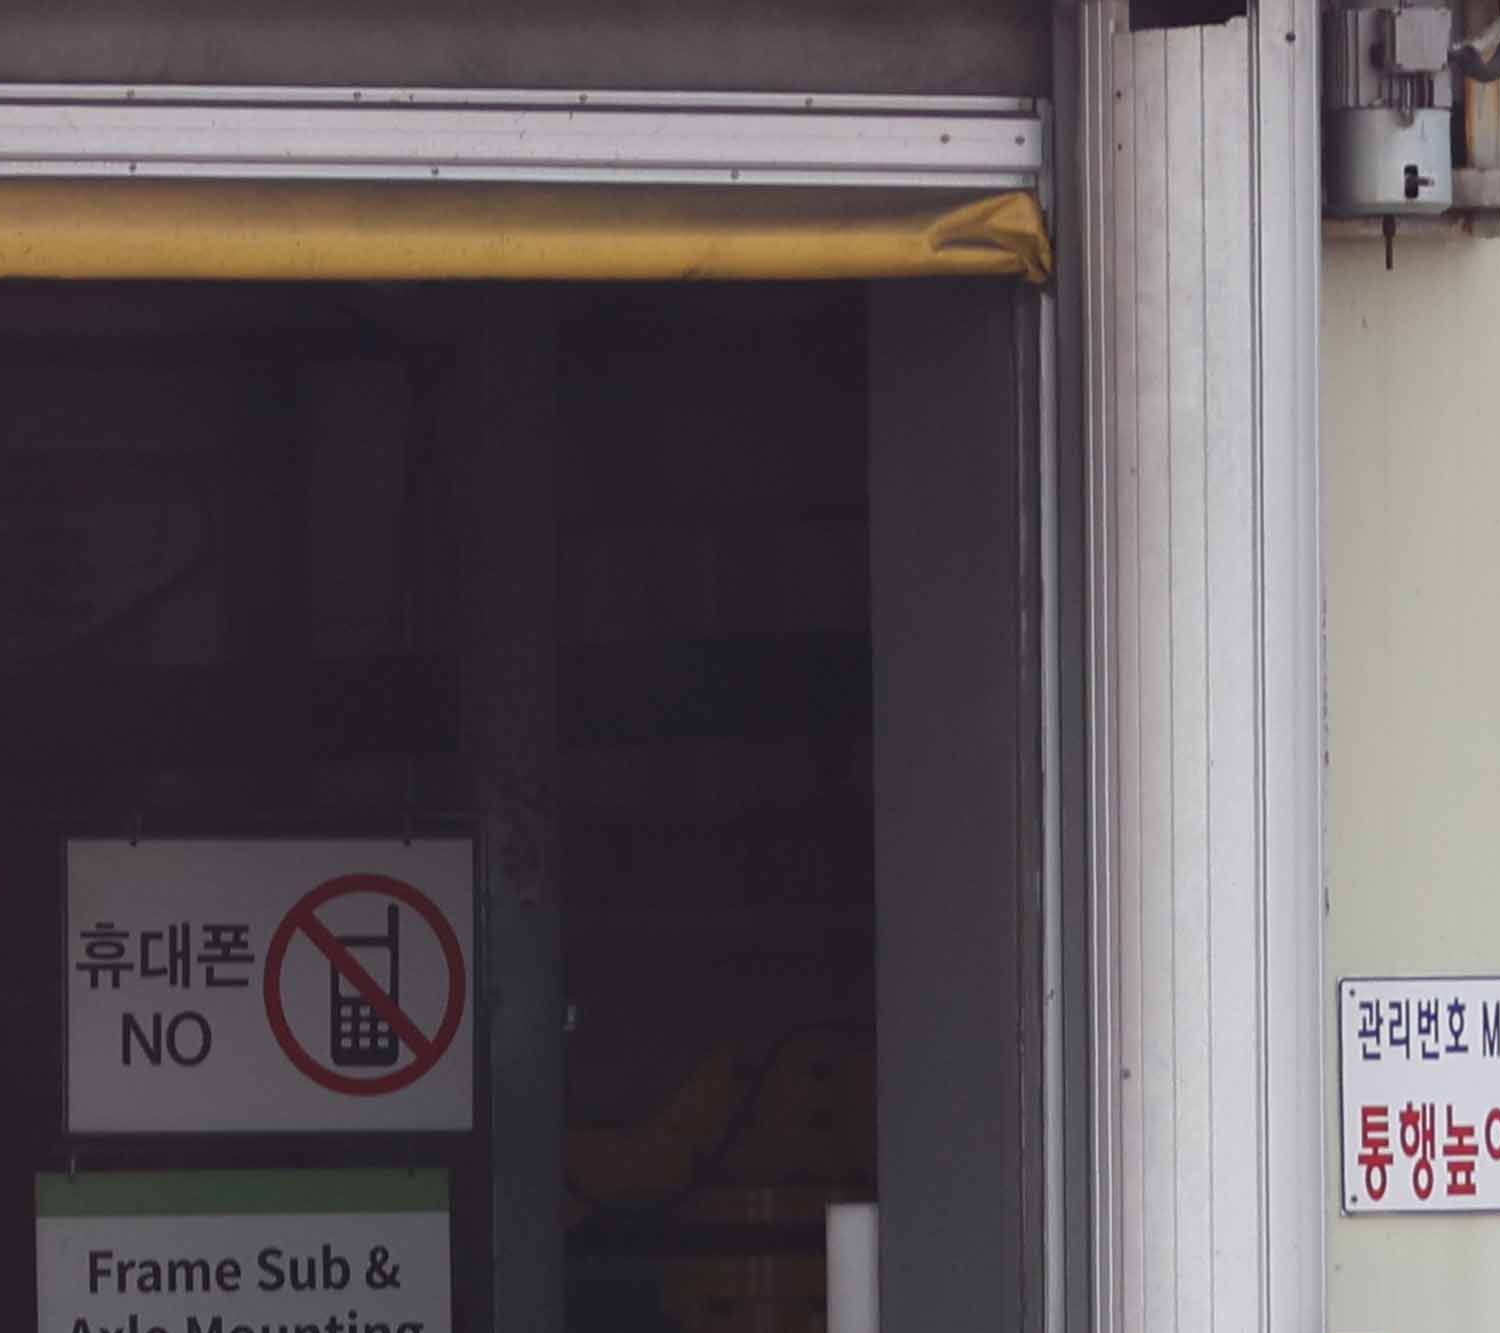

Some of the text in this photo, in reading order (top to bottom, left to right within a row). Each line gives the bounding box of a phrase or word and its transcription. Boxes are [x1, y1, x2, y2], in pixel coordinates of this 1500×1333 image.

[75, 922, 255, 990] 휴대폰
[121, 1012, 213, 1068] NO
[1357, 997, 1470, 1060] 관리번호
[87, 1245, 401, 1294] Frame Sub &
